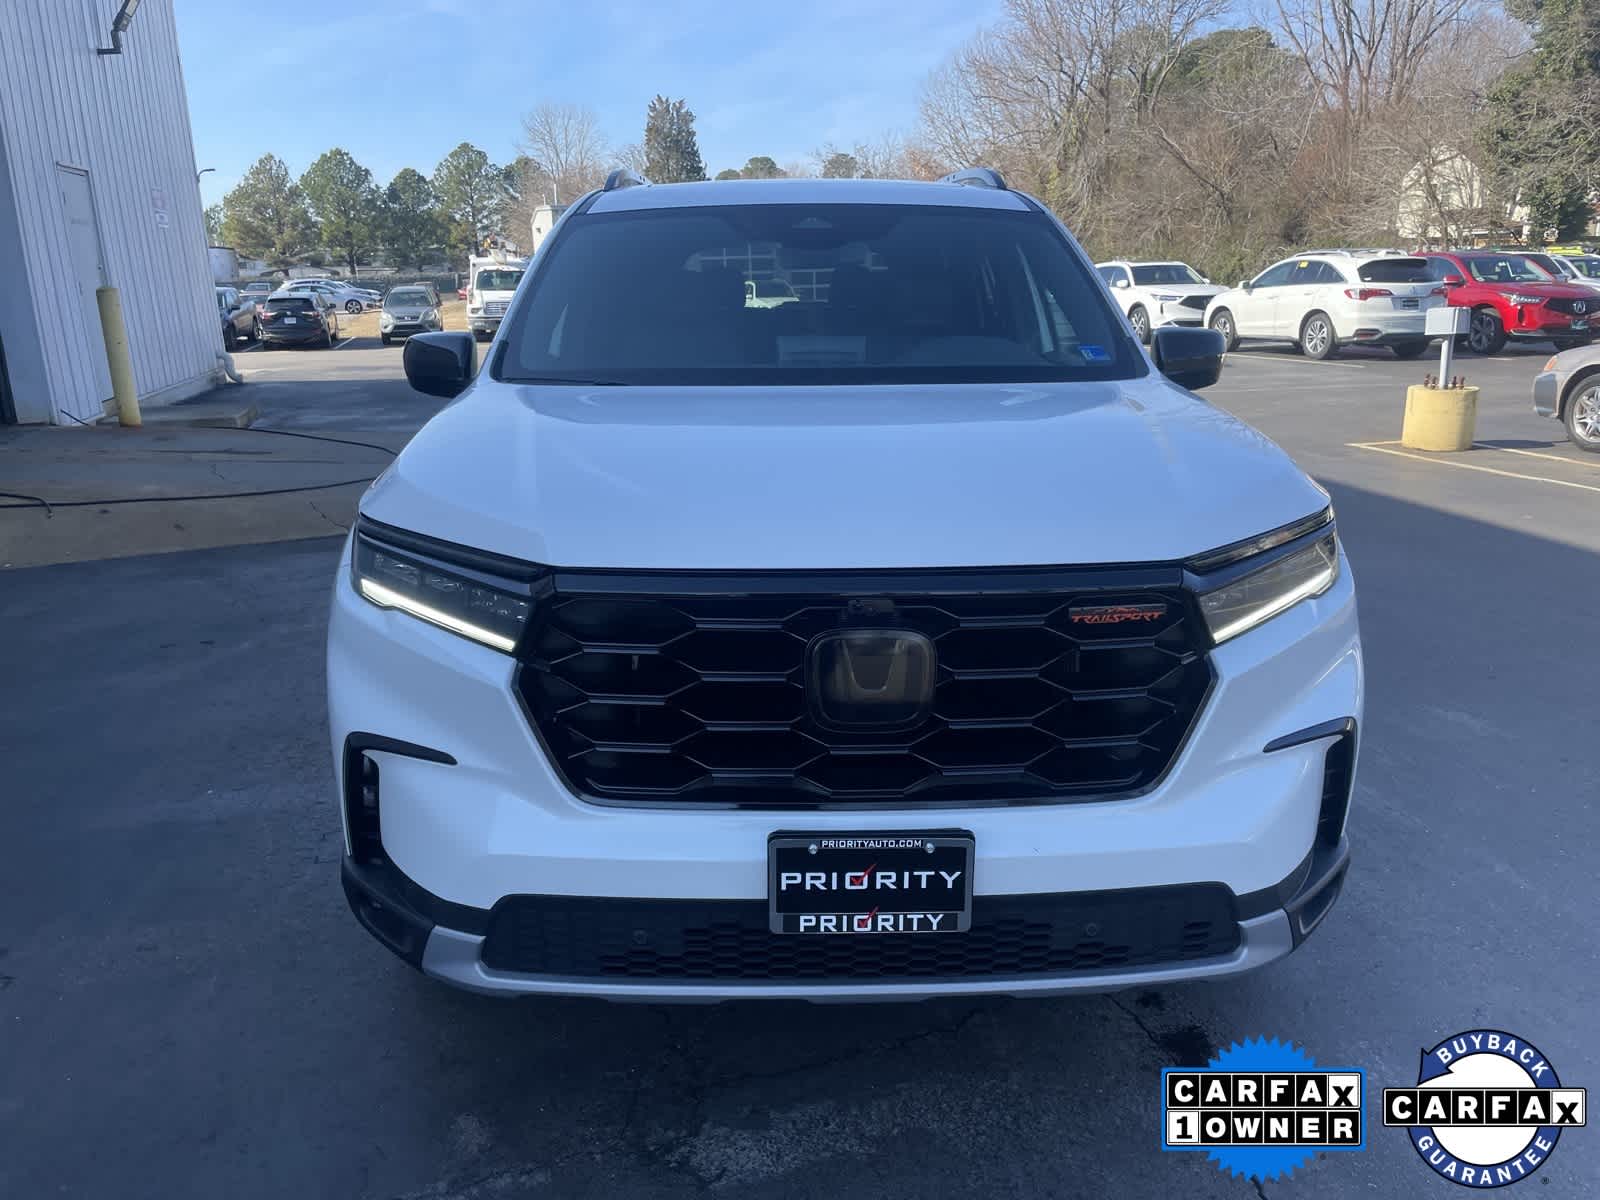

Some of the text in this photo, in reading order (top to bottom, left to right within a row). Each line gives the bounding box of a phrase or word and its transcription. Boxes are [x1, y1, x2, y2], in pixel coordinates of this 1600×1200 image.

[821, 839, 922, 849] PRIORITYAUTO.COM
[780, 870, 962, 891] PRIORITY
[799, 912, 945, 933] PRIORITY
